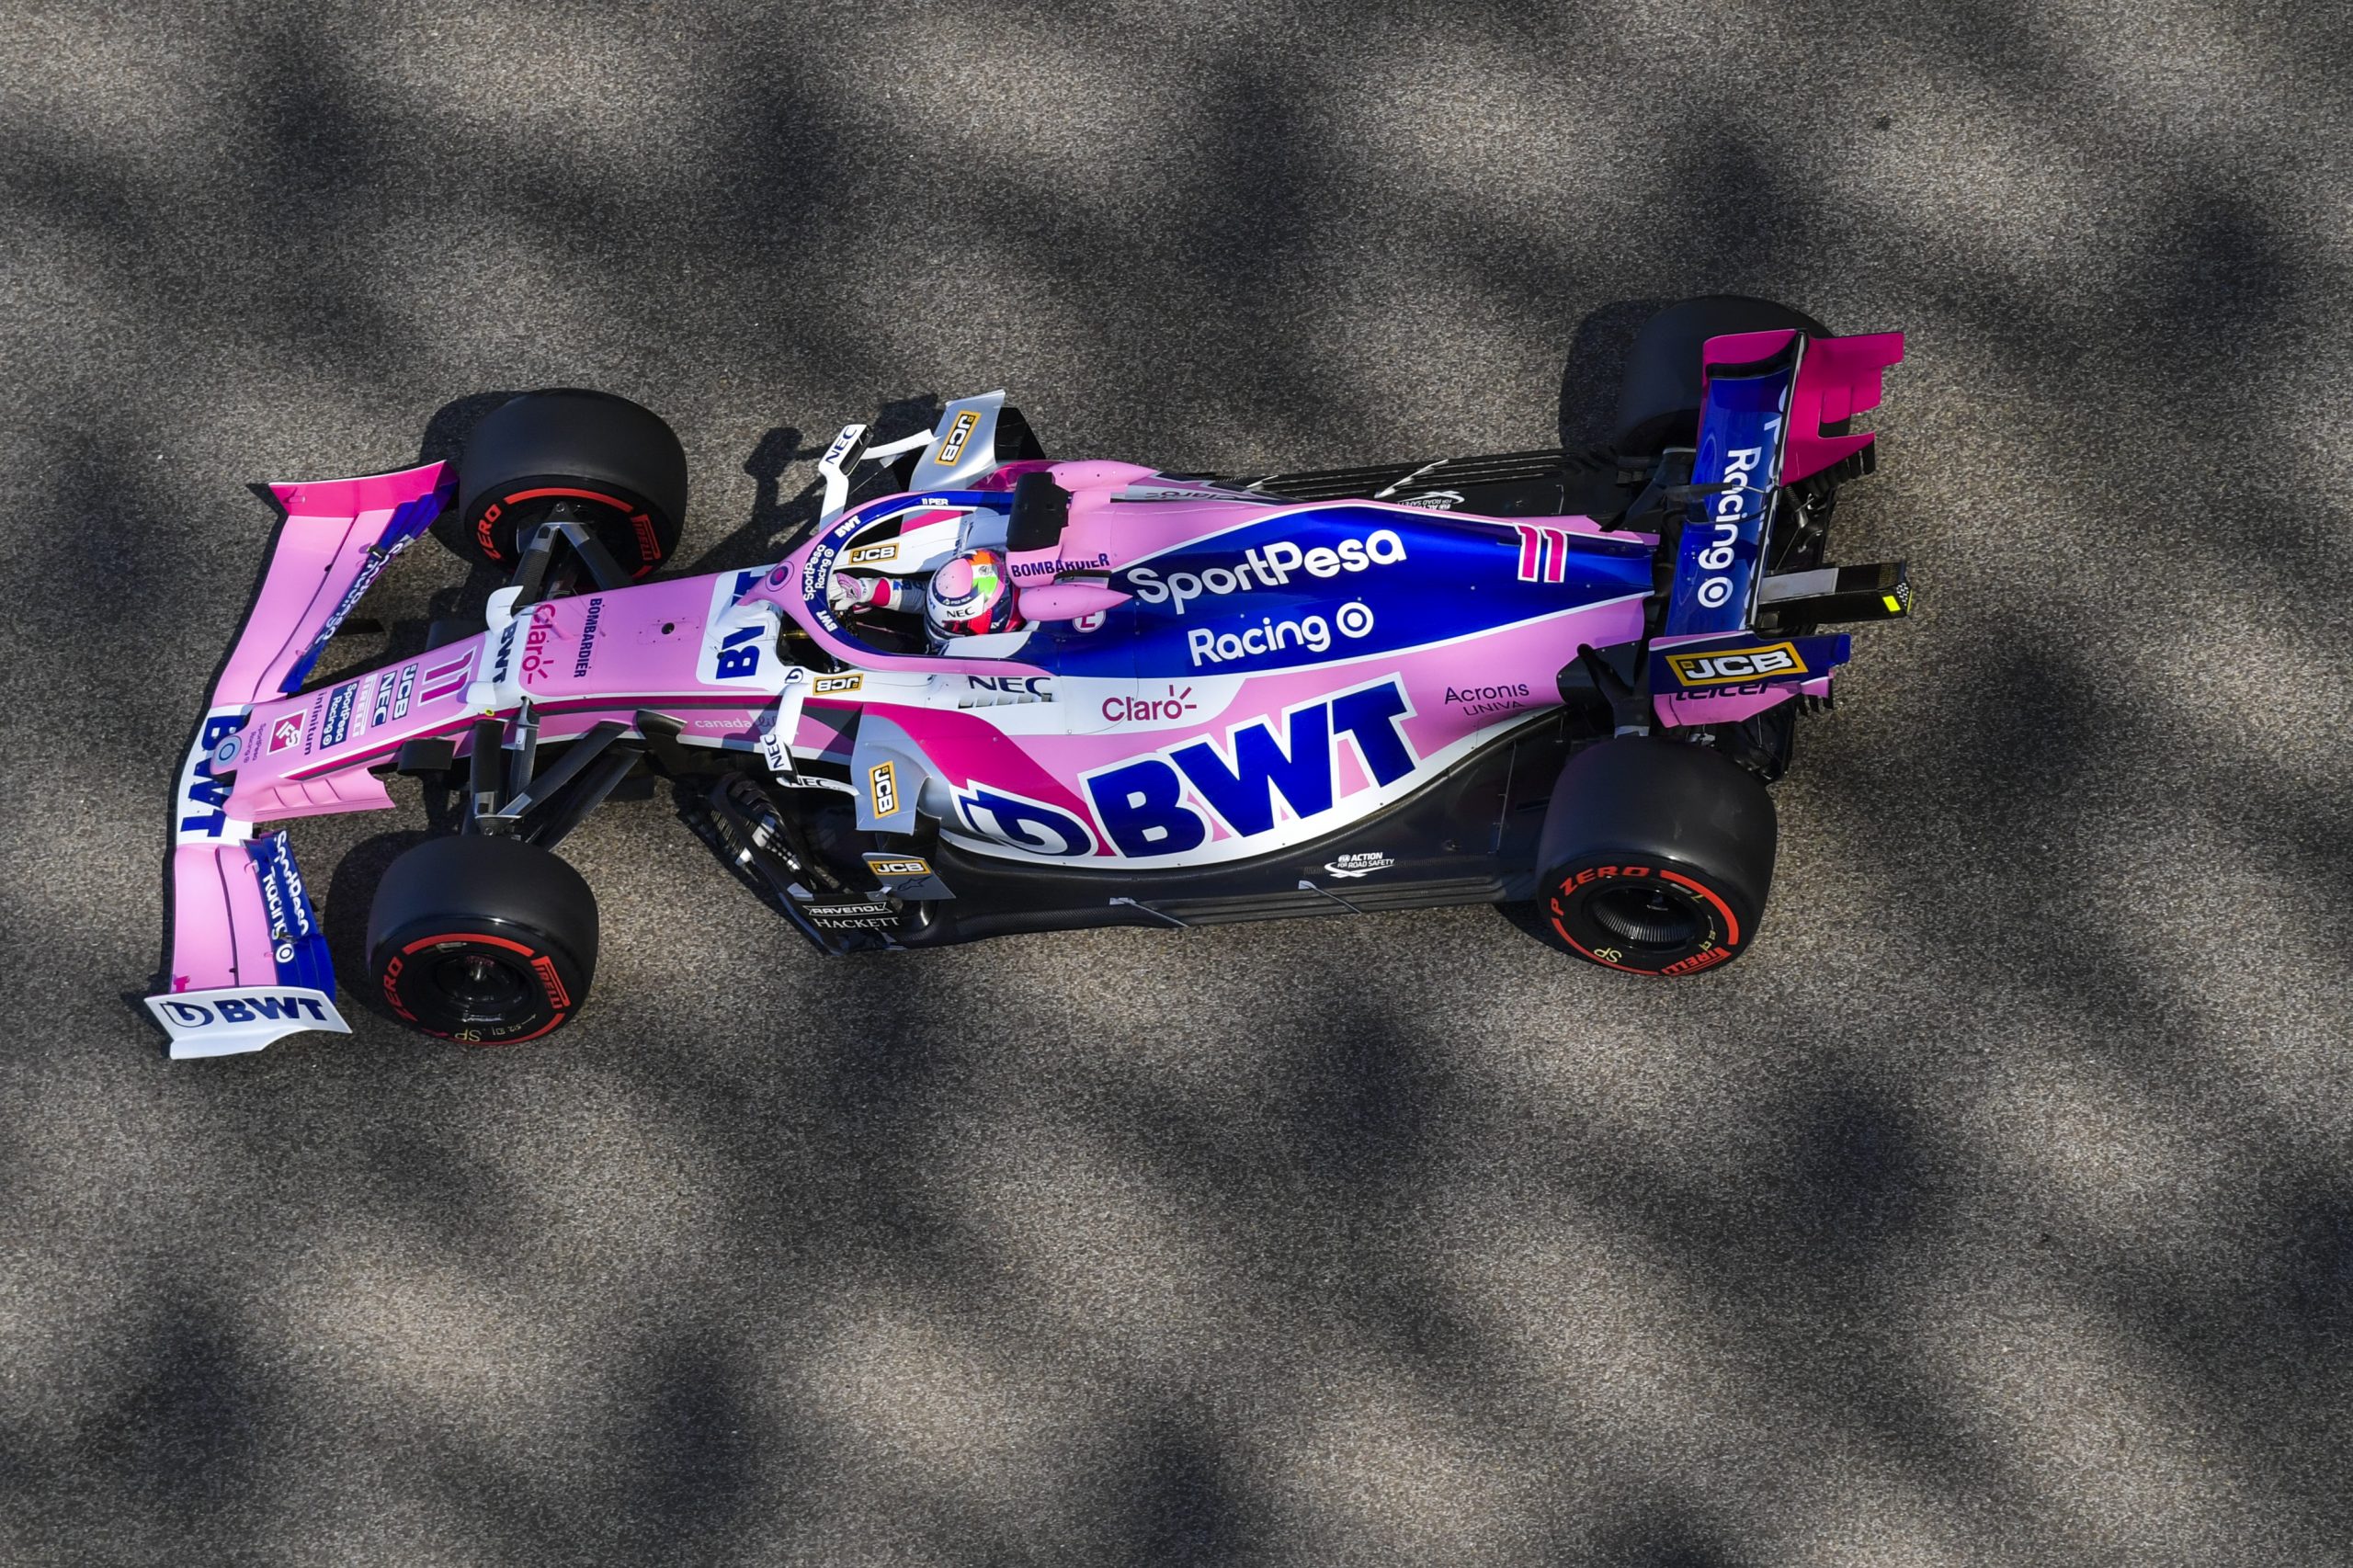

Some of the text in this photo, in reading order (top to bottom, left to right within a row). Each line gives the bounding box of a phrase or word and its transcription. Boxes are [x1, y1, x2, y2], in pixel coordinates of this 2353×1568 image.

[825, 426, 858, 464] NEC
[940, 415, 972, 461] JCB
[1698, 447, 1762, 570] Racing
[835, 515, 861, 538] BWT
[852, 547, 895, 562] JCB
[1011, 553, 1109, 577] BOMBARDIER
[1514, 523, 1567, 583] 11
[803, 544, 826, 601] SportPesa
[814, 559, 832, 589] Racing
[1127, 529, 1407, 614] SportPesa
[816, 610, 838, 632] BWT
[947, 607, 975, 618] NEC
[521, 603, 556, 673] Claro
[574, 597, 603, 678] BOMBARDIER
[1188, 615, 1331, 666] Racing
[418, 646, 478, 707] 11
[1686, 651, 1792, 678] JCB
[372, 673, 396, 725] NEC
[394, 665, 417, 718] JCB
[816, 677, 859, 691] JCB
[968, 676, 1052, 697] NEC
[1445, 684, 1529, 705] Acronis
[324, 695, 341, 733] Racing
[335, 683, 358, 743] SportPesa
[352, 673, 379, 738] PIRELLI
[1102, 696, 1183, 722] Claro
[1463, 700, 1526, 716] UNIVA
[304, 691, 327, 756] infinitum
[695, 717, 752, 729] canada
[764, 734, 784, 768] NEC
[791, 778, 830, 787] NEC
[1086, 680, 1415, 858] BWT
[874, 769, 894, 813] JCB
[877, 863, 924, 872] JCB
[1351, 852, 1382, 861] ACTION
[1369, 858, 1394, 867] SAFETY
[1551, 866, 1650, 915] P ZERO
[812, 905, 883, 915] RAVENOL
[813, 917, 899, 928] HACKETT
[1661, 947, 1733, 976] PIRELLI
[530, 956, 571, 1009] PIRELLI
[212, 996, 327, 1025] BWT
